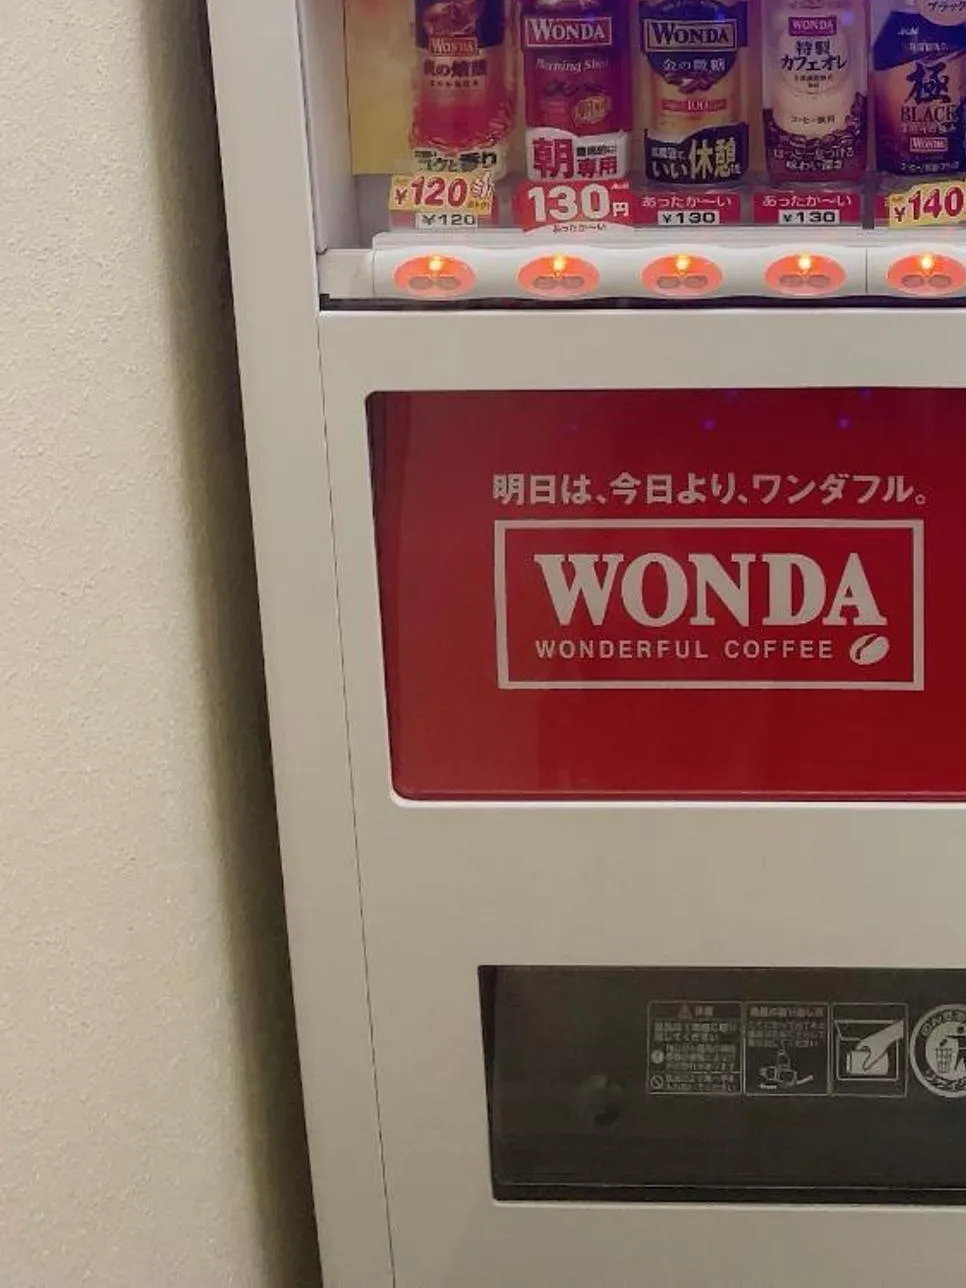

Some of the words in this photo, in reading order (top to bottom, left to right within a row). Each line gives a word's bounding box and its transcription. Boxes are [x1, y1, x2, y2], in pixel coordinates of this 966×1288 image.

[531, 20, 604, 39] WONDA
[651, 22, 728, 44] WONDA
[792, 20, 834, 31] WONDA
[781, 54, 848, 71] カフェオレ
[532, 139, 573, 179] 朝
[492, 472, 926, 506] 明日は、今日より、ワンダフル。
[533, 552, 888, 628] WONDA
[535, 639, 708, 659] WONDERFUL
[724, 639, 834, 659] COFFEE
